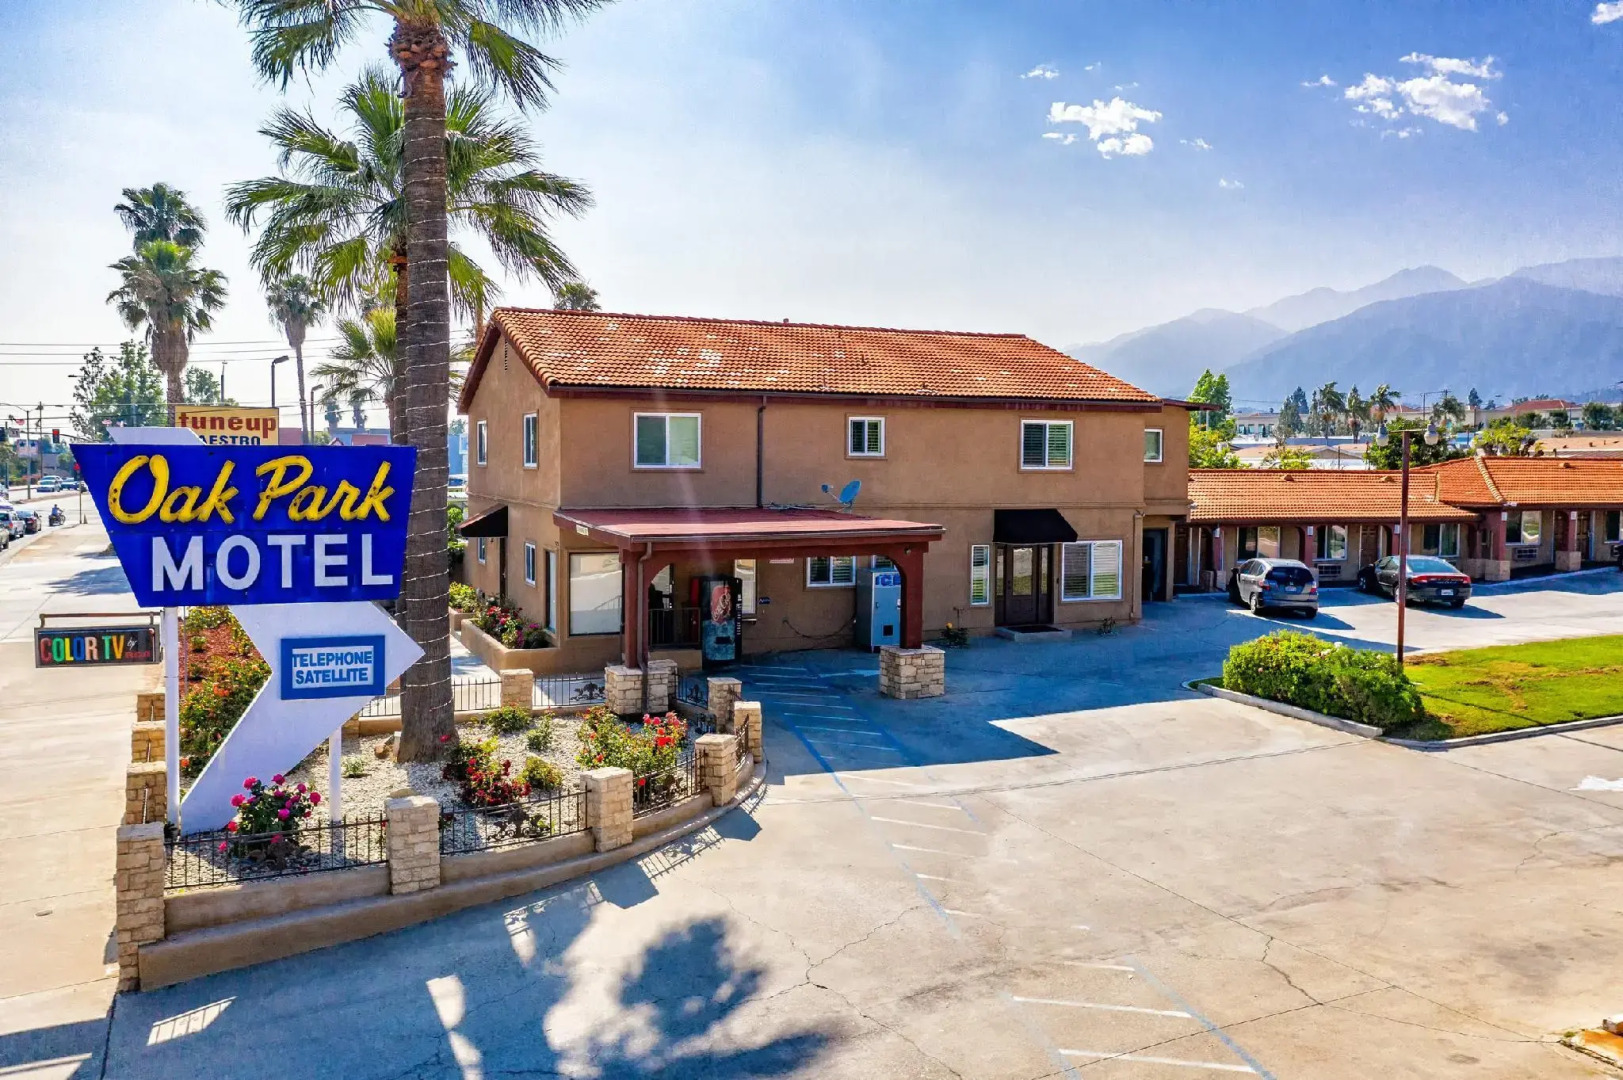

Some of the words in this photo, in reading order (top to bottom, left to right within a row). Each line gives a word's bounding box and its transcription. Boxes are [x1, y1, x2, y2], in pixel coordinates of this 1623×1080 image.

[178, 412, 276, 439] tuneup
[199, 434, 261, 446] AESTRO
[108, 454, 239, 525] Oak
[253, 454, 394, 522] Park
[152, 533, 394, 592] MOTEL
[40, 636, 98, 664] COLOR
[102, 635, 124, 660] TV
[292, 650, 373, 668] TELEPHONE
[295, 667, 369, 684] SATELLITE
